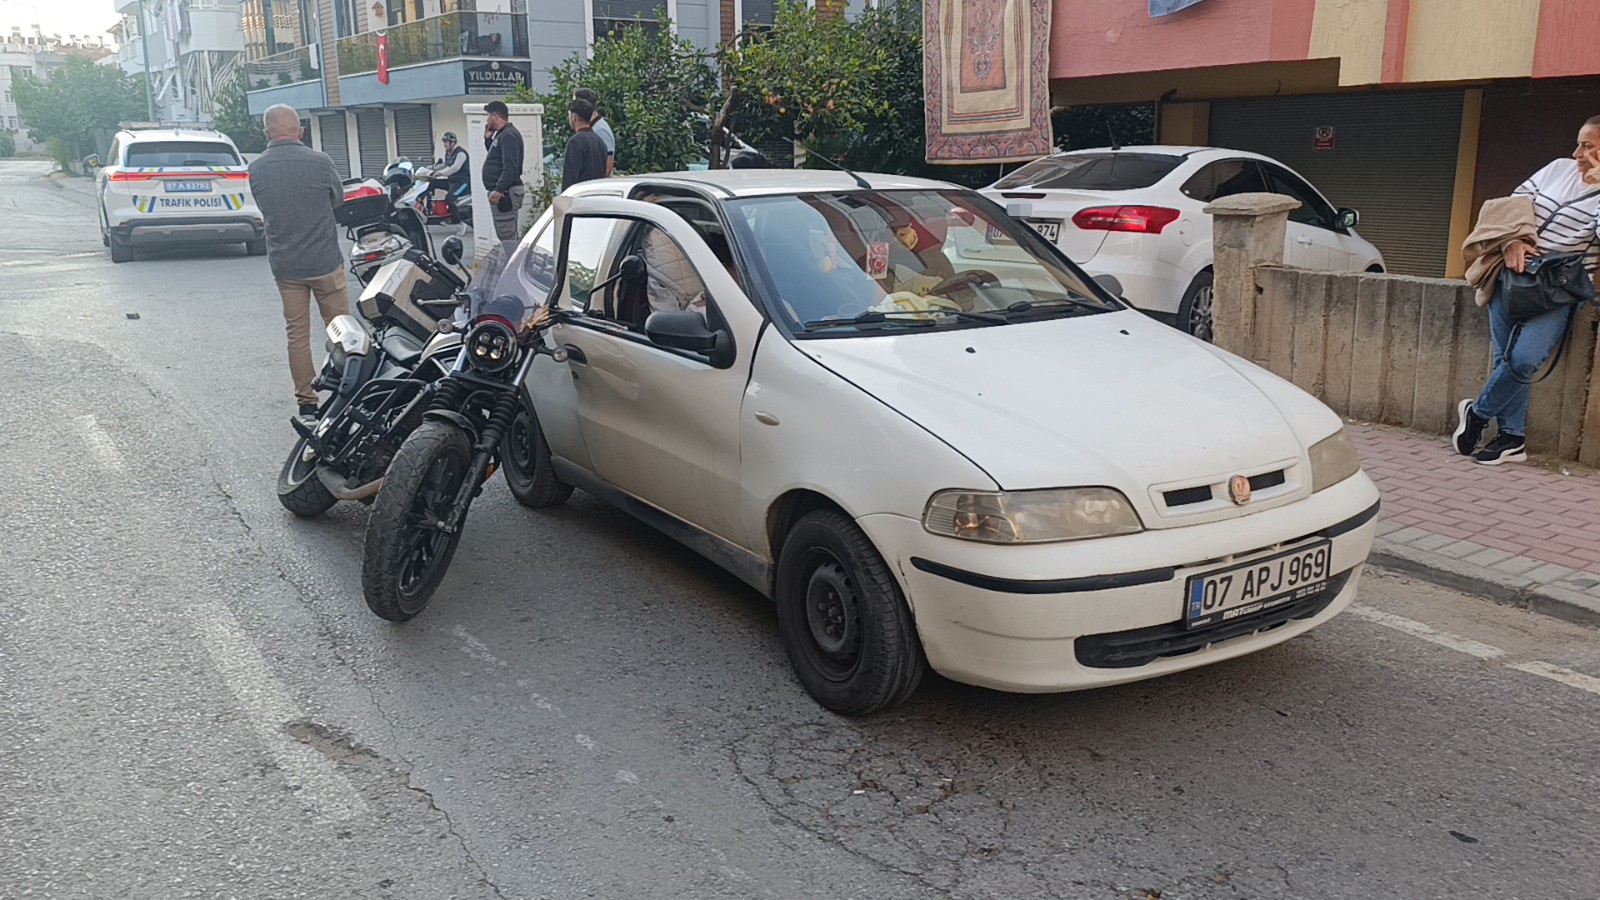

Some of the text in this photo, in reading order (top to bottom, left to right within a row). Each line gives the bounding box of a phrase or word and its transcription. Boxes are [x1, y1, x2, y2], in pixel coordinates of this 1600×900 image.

[468, 71, 522, 82] YILDIZLAR
[160, 197, 221, 207] TRAFİK POLİSİ
[1191, 601, 1201, 611] TR
[1203, 575, 1233, 610] 07
[1241, 561, 1285, 601] APJ
[1287, 548, 1326, 586] 969
